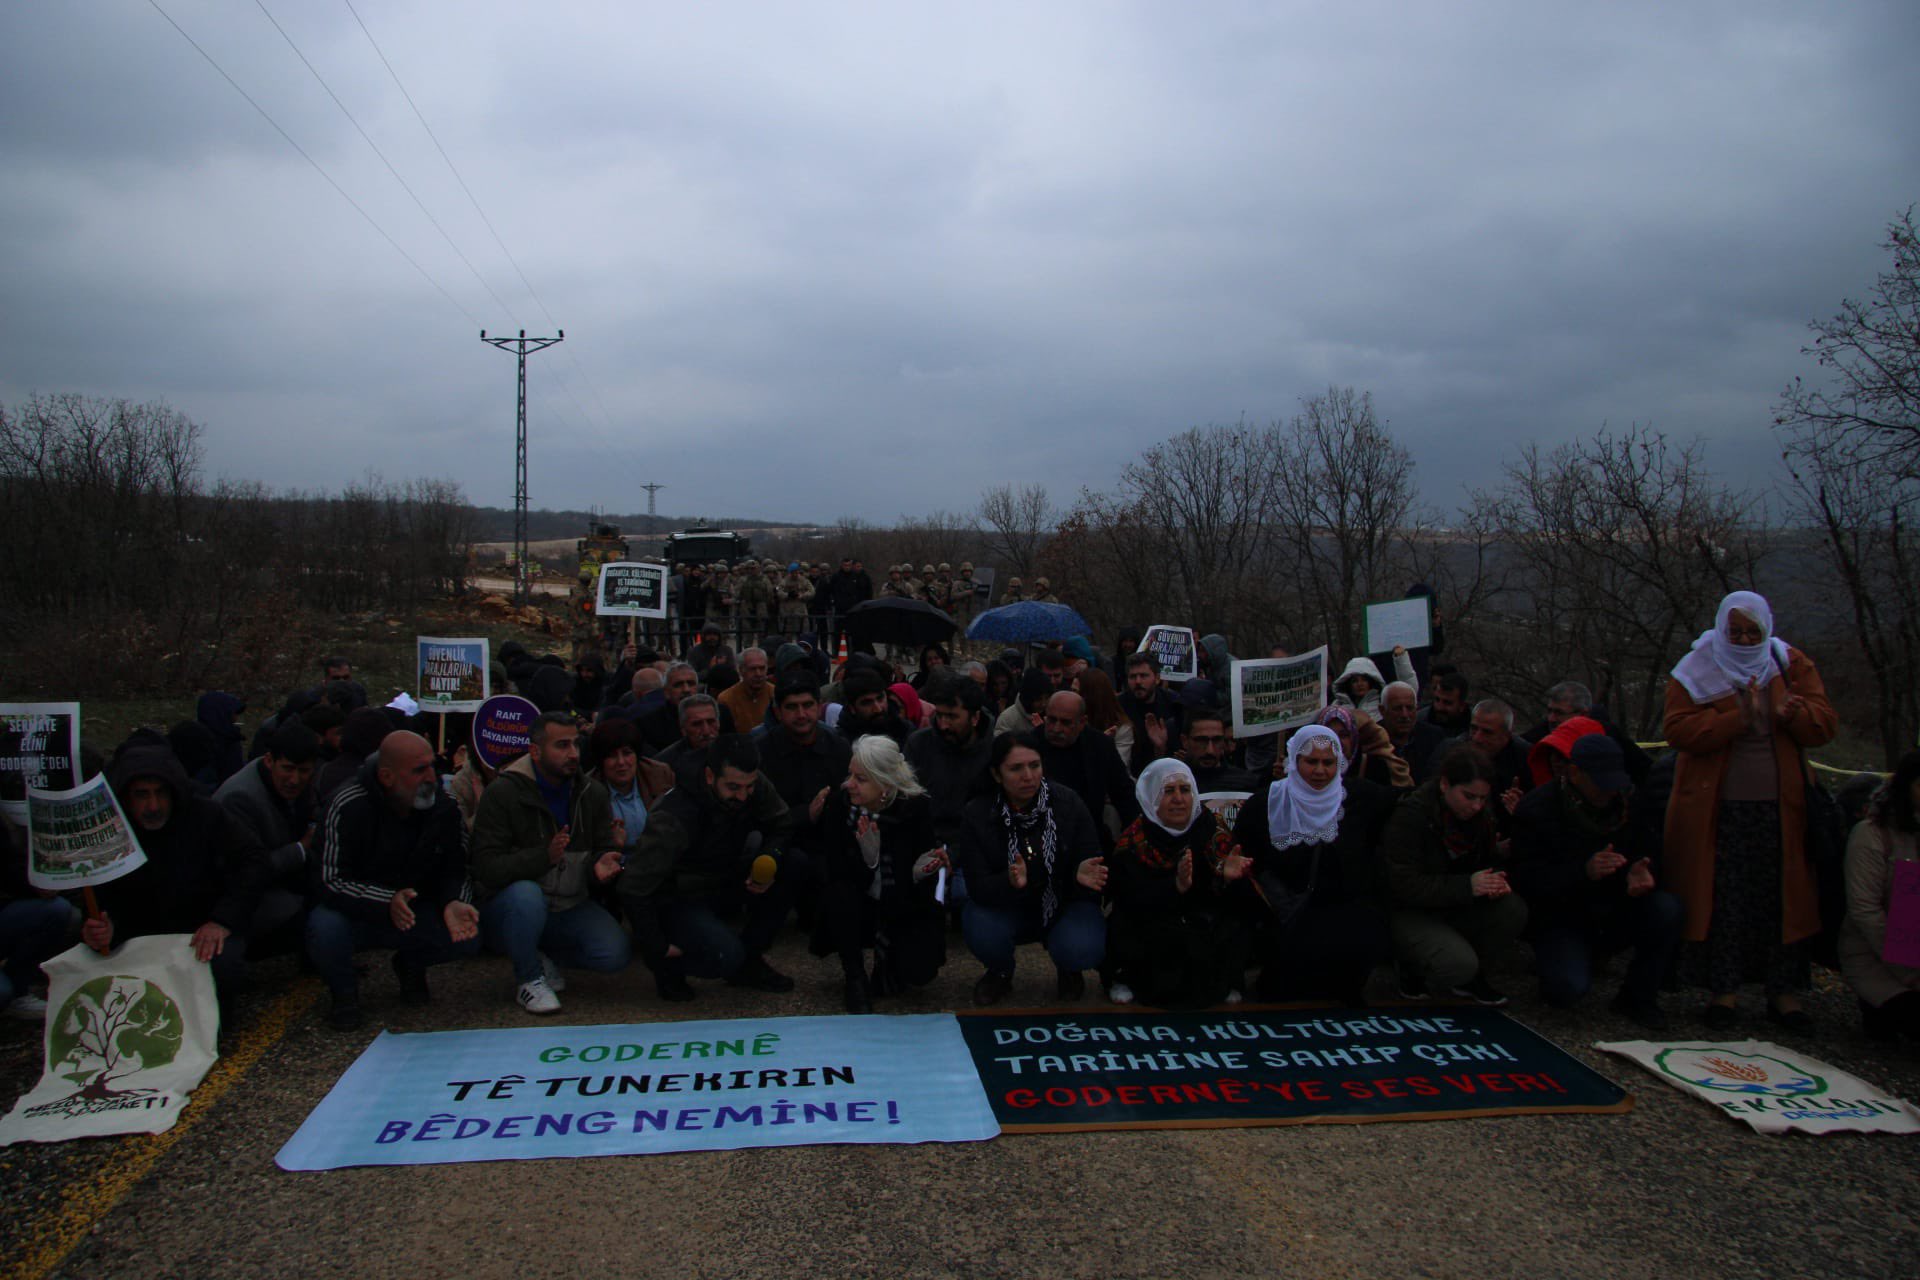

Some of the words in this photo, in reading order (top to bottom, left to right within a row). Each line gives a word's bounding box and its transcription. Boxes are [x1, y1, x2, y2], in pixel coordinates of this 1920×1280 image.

[429, 677, 461, 691] HAYIR!
[495, 709, 523, 721] RANT
[481, 728, 532, 746] DAYANIŞMA
[538, 1032, 782, 1064] GODERNÊ
[993, 1022, 1197, 1046] DOĞANA,
[993, 1049, 1250, 1075] TARİHİNE
[1258, 1043, 1401, 1068] SAHİP
[1411, 1041, 1520, 1067] ÇIK!
[446, 1074, 528, 1102] TÊ
[1004, 1078, 1332, 1109] GODERNÊ'YE
[1339, 1074, 1441, 1100] SES
[1441, 1071, 1569, 1098] VER!
[374, 1111, 616, 1145] BÊDENG
[632, 1098, 900, 1133] NEMİNE!
